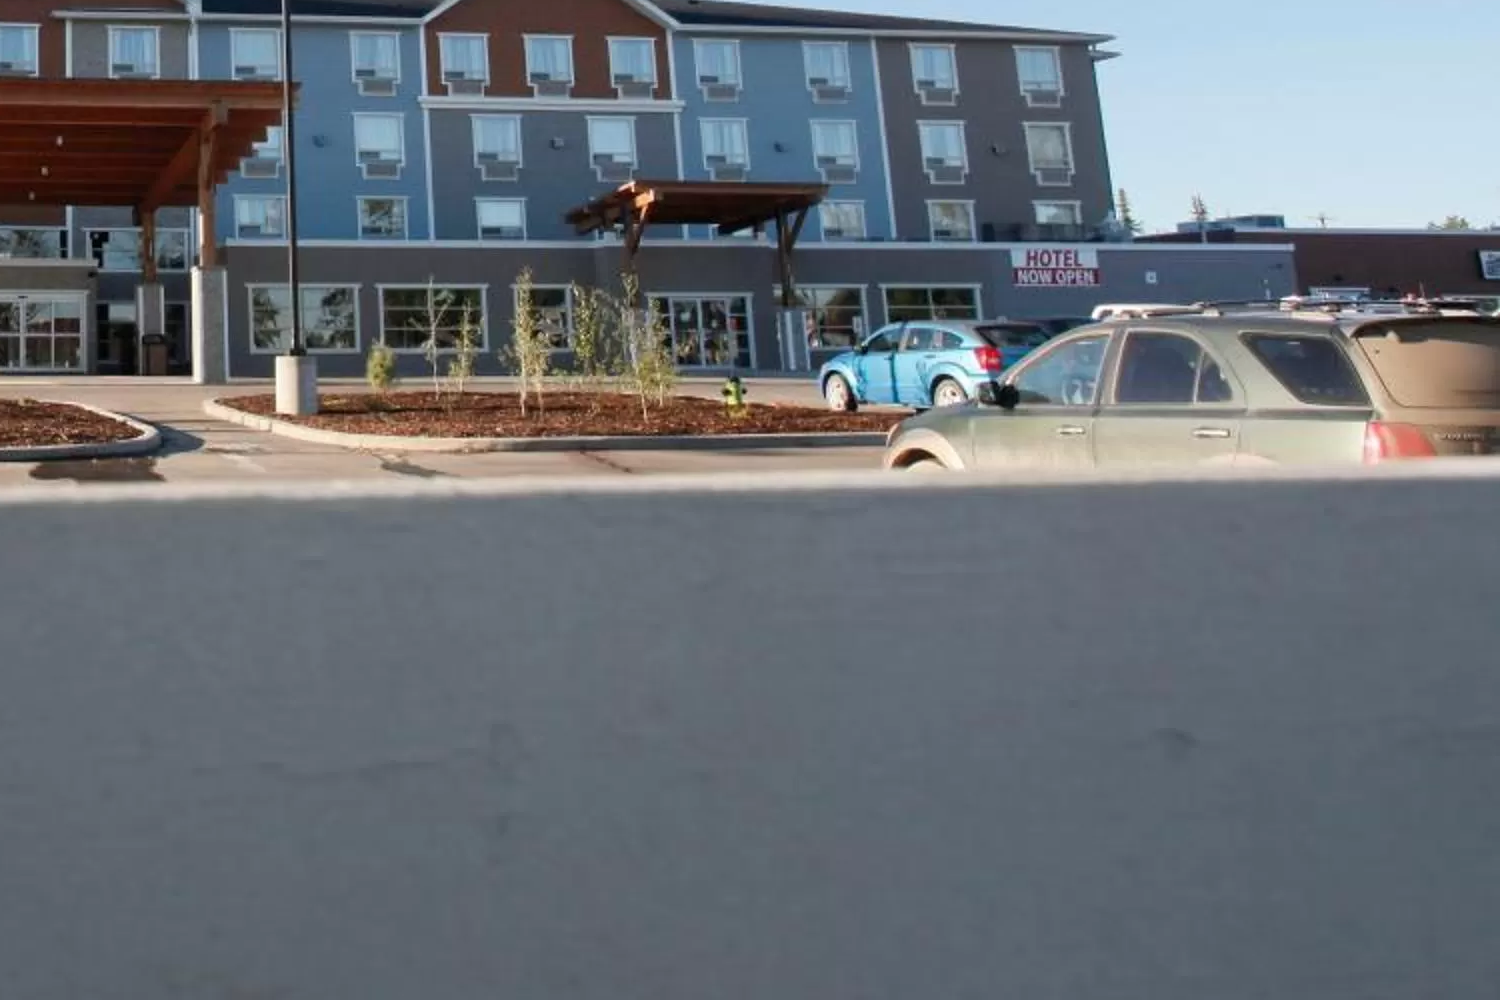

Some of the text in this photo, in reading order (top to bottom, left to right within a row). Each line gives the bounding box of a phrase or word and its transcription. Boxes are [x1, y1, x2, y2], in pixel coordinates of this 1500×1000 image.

[1026, 248, 1083, 267] HOTEL
[1017, 269, 1095, 284] NOW OPEN
